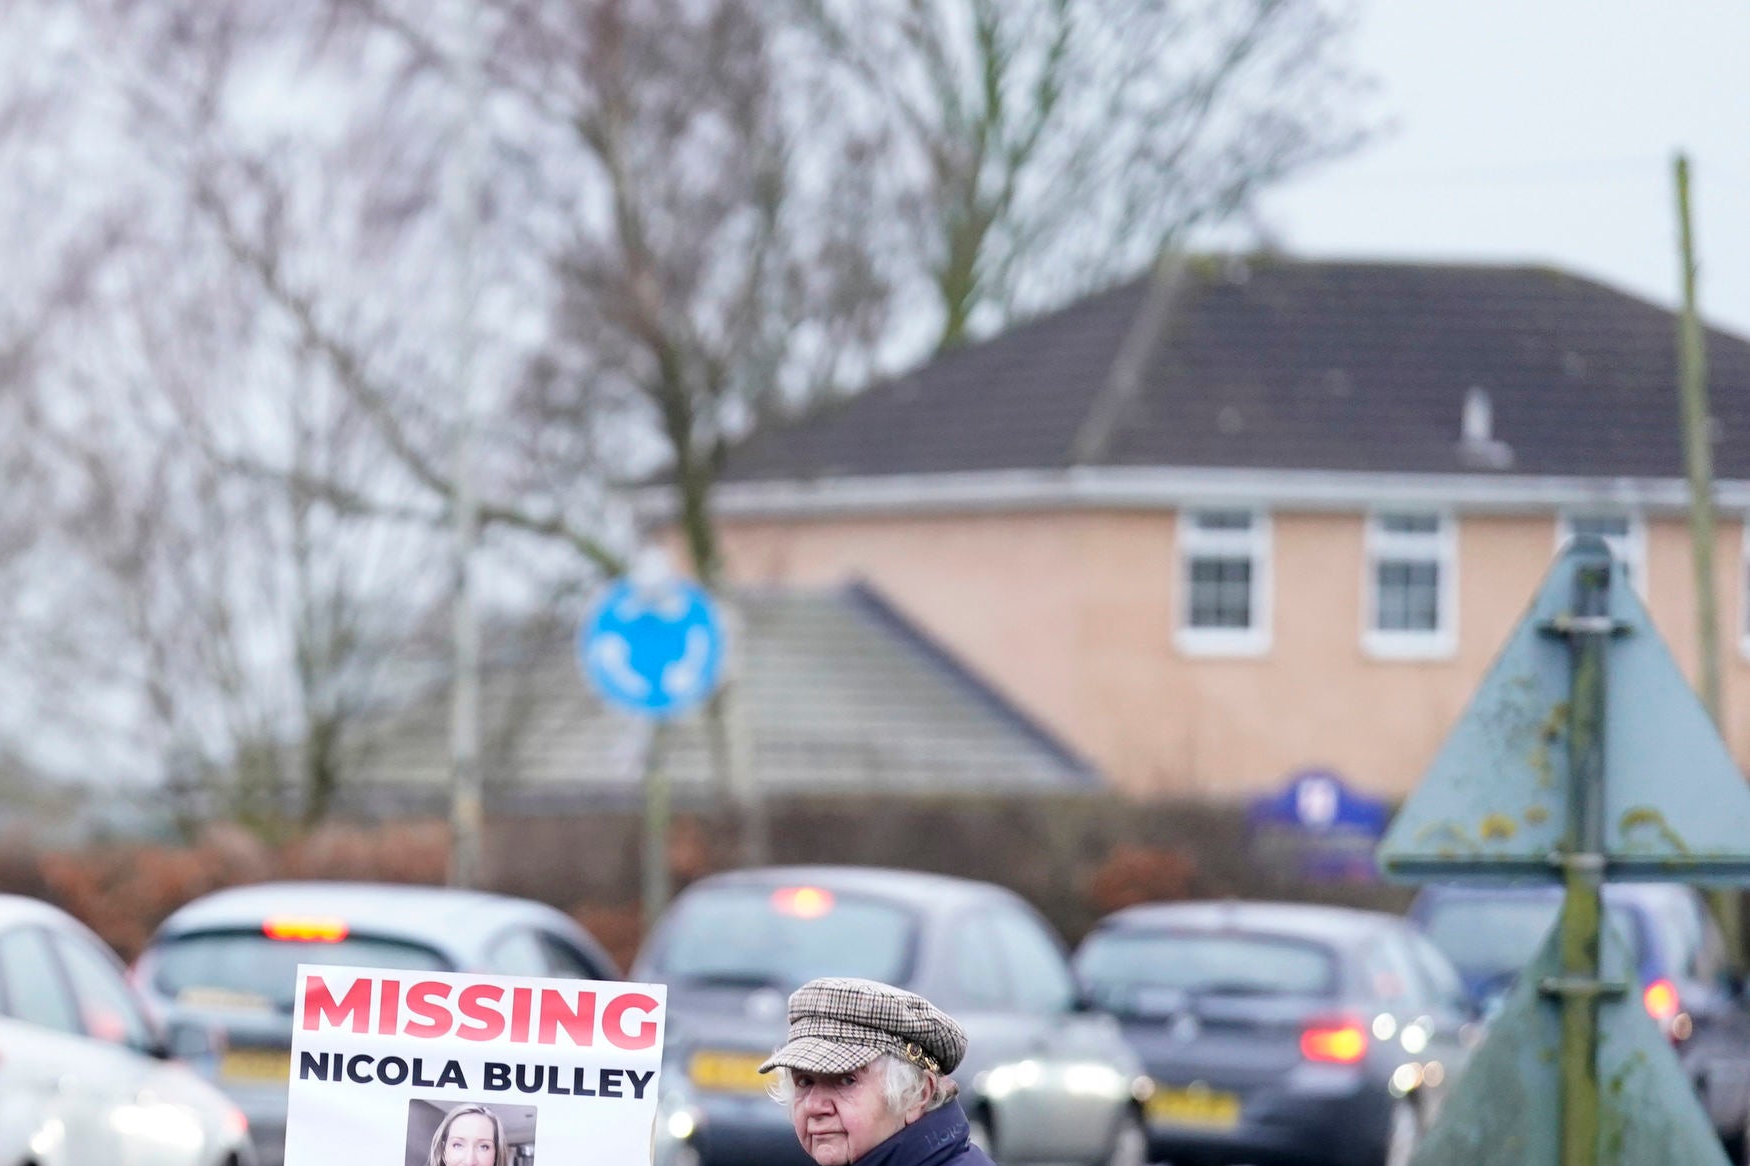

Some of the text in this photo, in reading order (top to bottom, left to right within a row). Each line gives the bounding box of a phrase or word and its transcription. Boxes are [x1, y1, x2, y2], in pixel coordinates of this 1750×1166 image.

[302, 974, 660, 1051] MISSING
[299, 1051, 468, 1090] NICOLA
[483, 1061, 655, 1099] BULLEY
